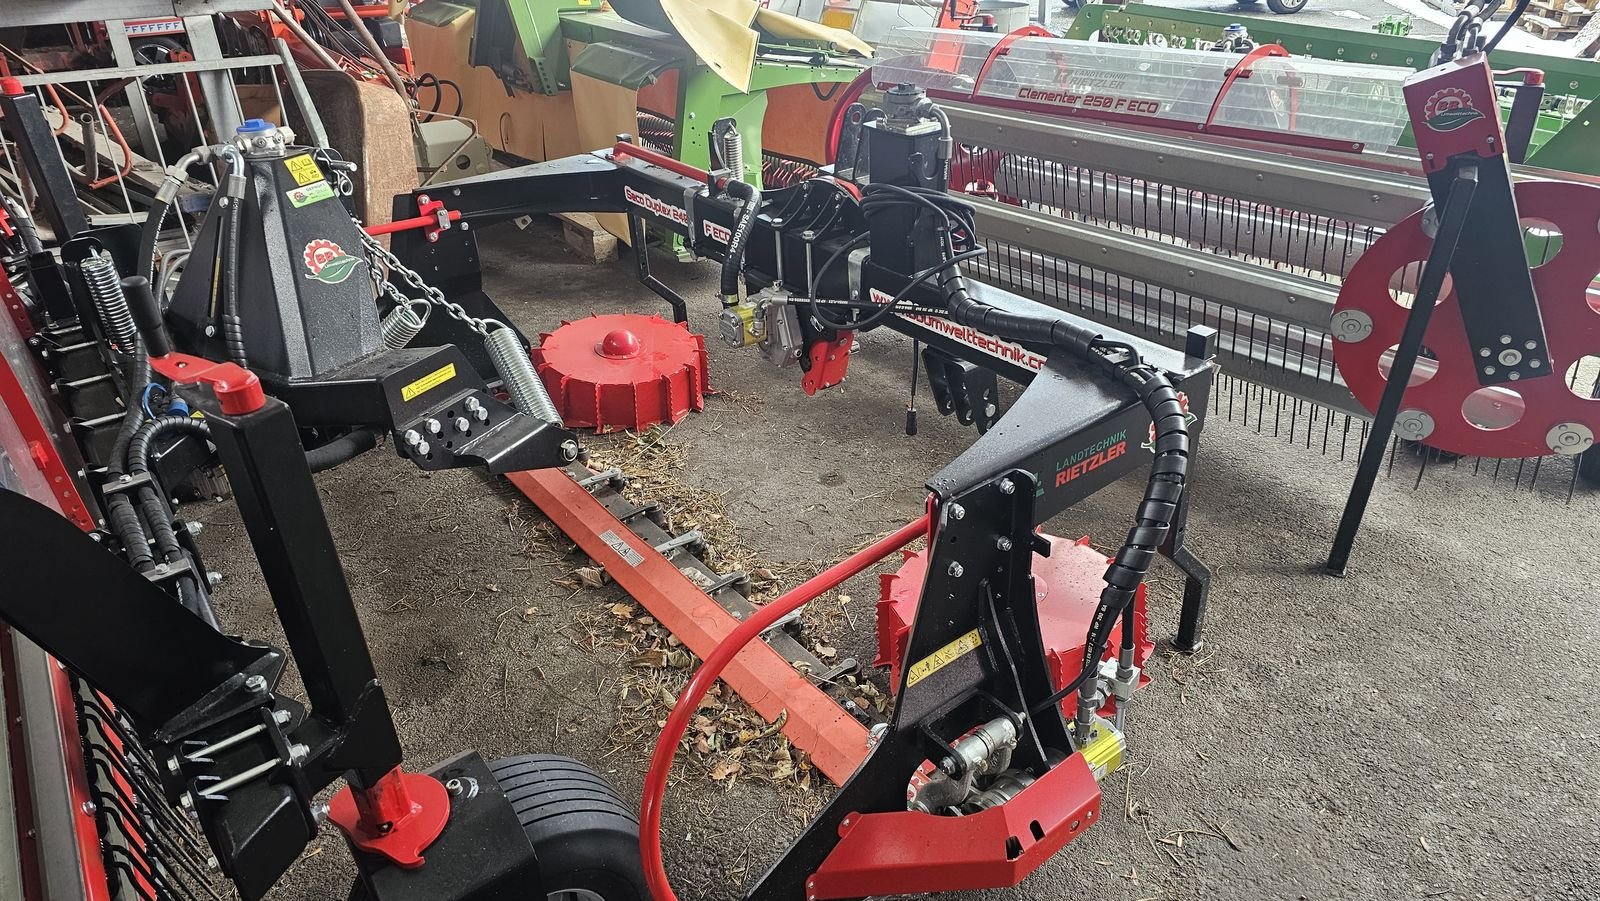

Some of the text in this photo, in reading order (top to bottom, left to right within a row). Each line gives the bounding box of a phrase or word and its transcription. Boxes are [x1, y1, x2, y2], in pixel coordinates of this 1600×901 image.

[1018, 87, 1159, 114] Clementer 250 F ECO
[1069, 76, 1125, 89] RIETZLER
[645, 195, 672, 217] Duplex
[705, 223, 713, 235] F
[729, 213, 750, 253] SAE100R4
[315, 251, 335, 264] BB
[1055, 429, 1127, 472] LANDTECHNIK
[1055, 441, 1127, 488] RIETZLER
